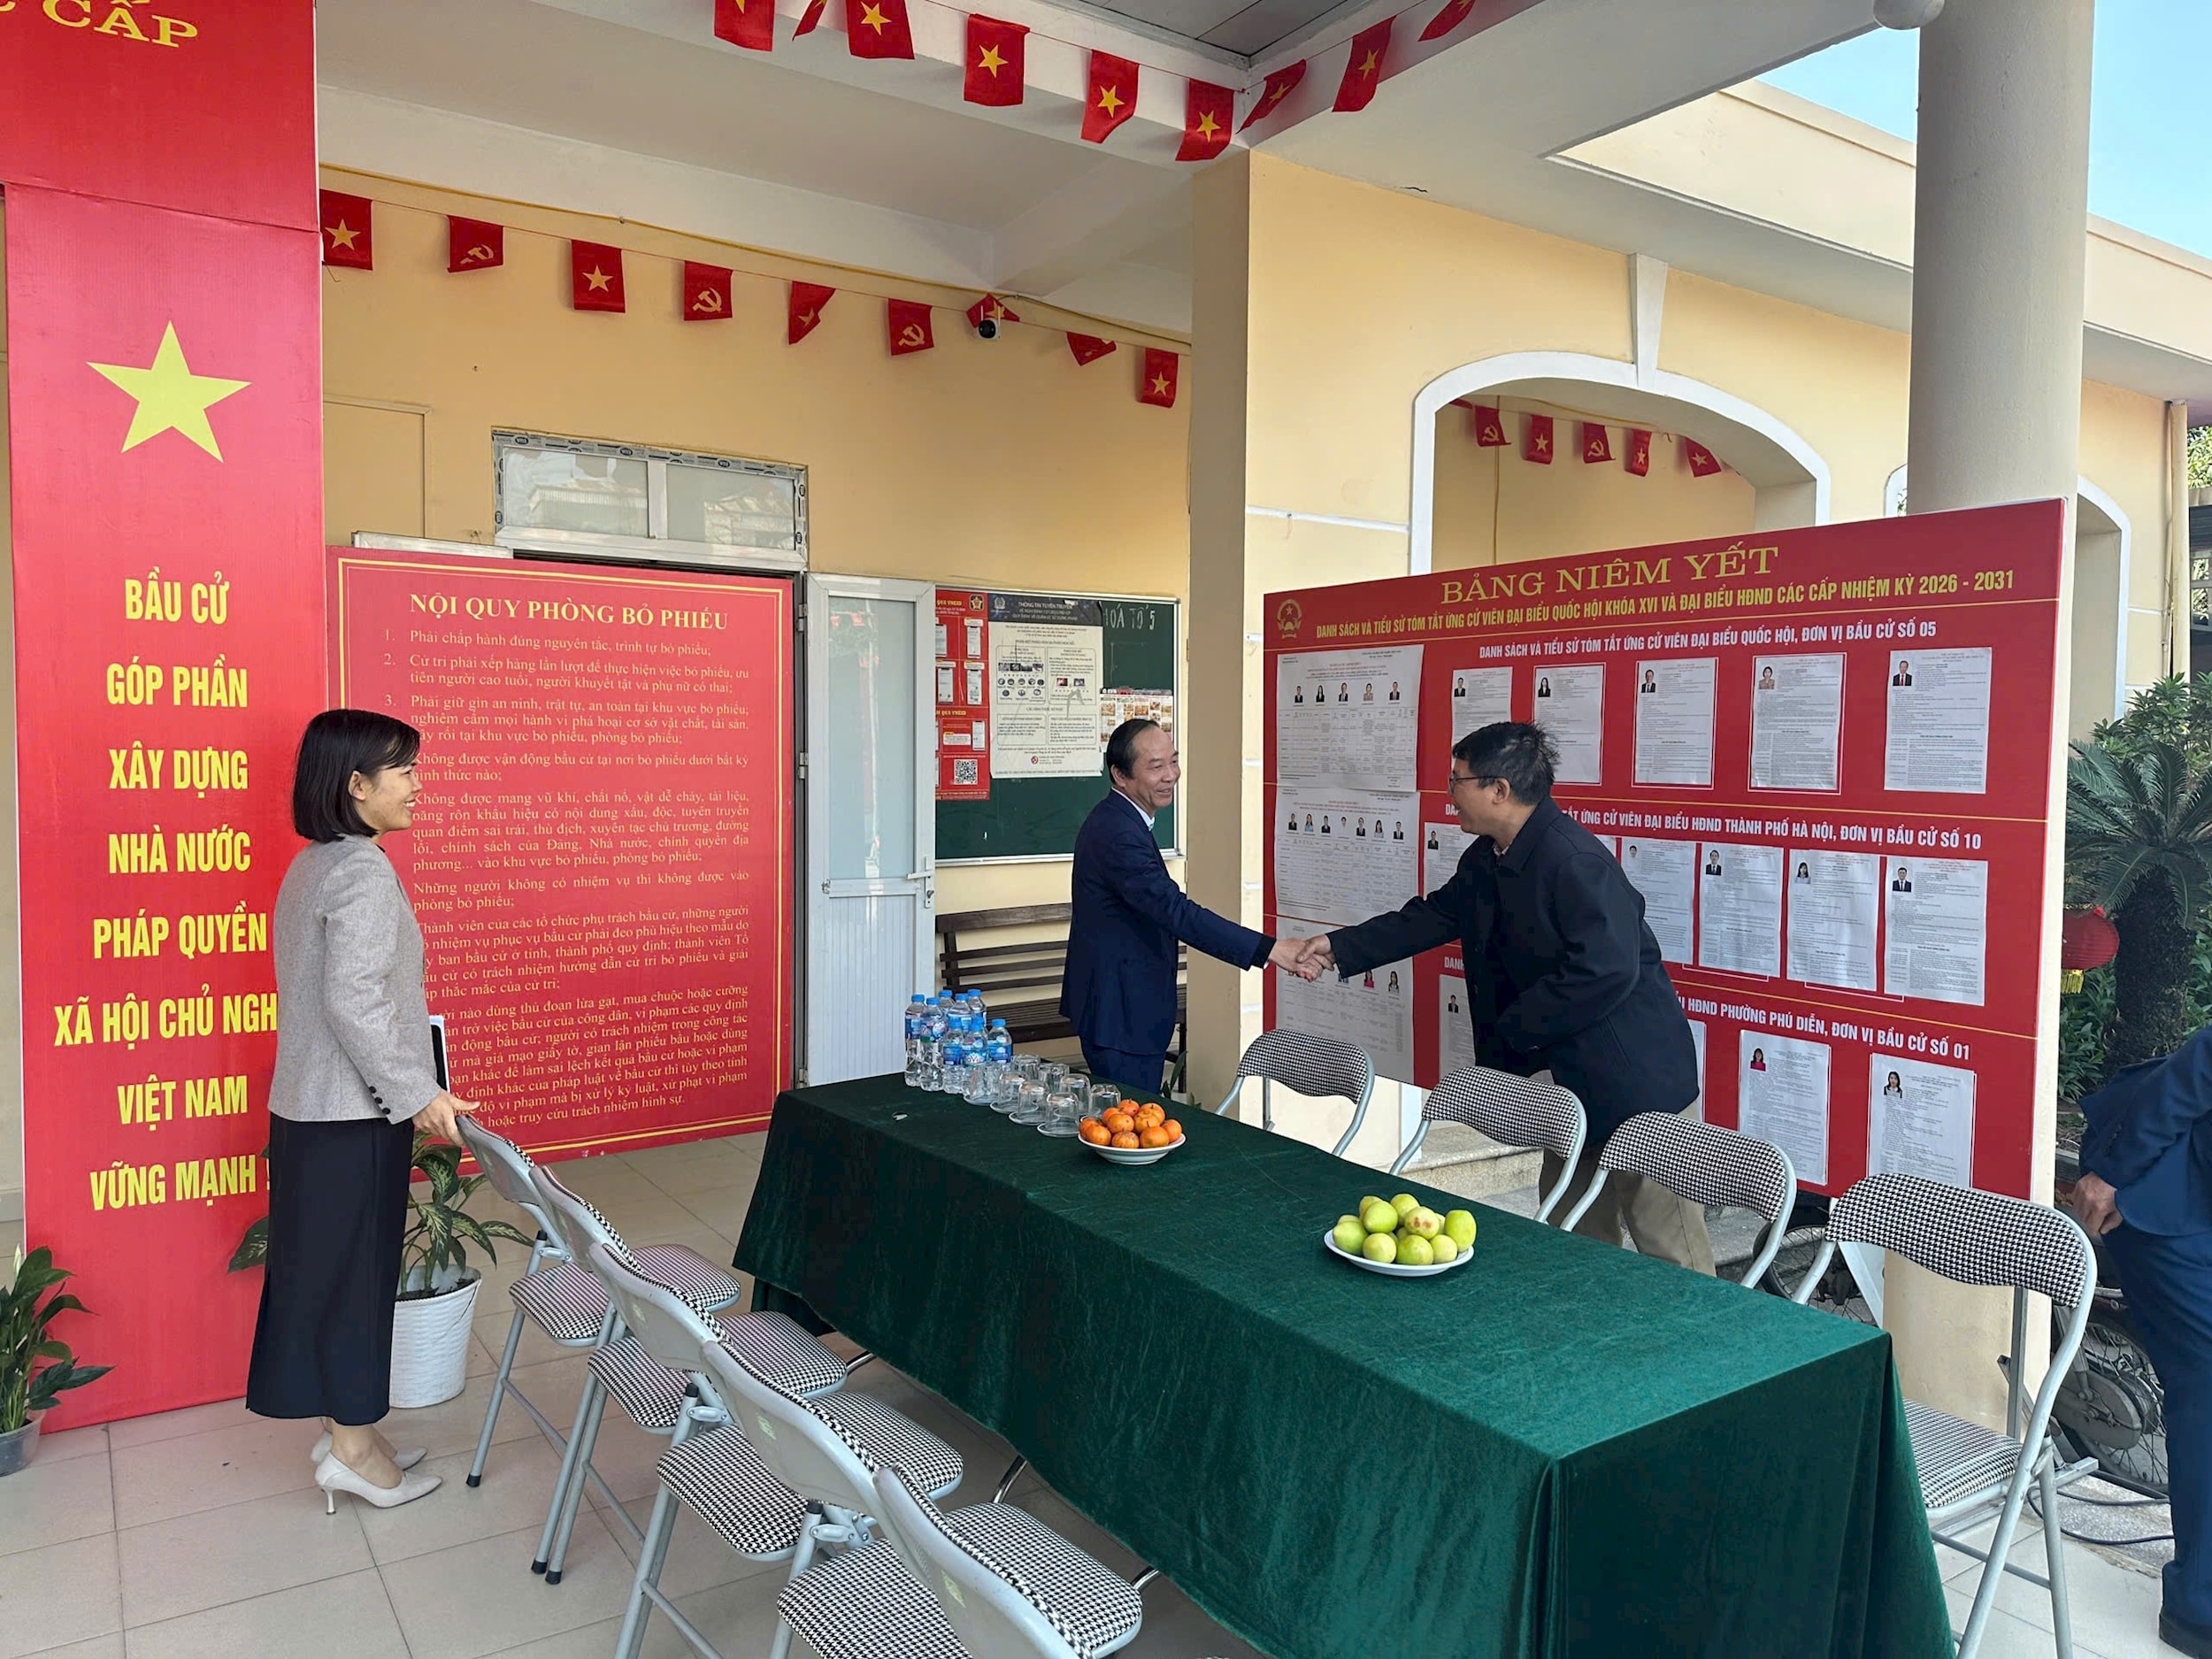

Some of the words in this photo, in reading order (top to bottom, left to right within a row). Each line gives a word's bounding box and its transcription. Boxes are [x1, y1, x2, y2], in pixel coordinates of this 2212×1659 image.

[125, 567, 181, 621] BẦU
[190, 572, 229, 623] CỬ
[1440, 572, 1545, 603] BẢNG
[1555, 557, 1671, 592] NIÊM
[1683, 541, 1778, 580] YẾT
[410, 592, 457, 618] NỘI
[465, 597, 521, 619] QUY
[527, 597, 614, 623] PHÒNG
[621, 603, 654, 625] BỎ
[660, 607, 727, 629] PHIẾU
[1149, 611, 1156, 630] 5
[1317, 624, 1337, 637] DANH
[1338, 622, 1360, 636] SÁCH
[1361, 621, 1371, 634] VÀ
[1373, 615, 1391, 634] TIỂU
[1393, 614, 1405, 632] SỬ
[1407, 615, 1425, 631] TÓM
[1427, 611, 1443, 629] TẮT
[1445, 612, 1464, 628] ỨNG
[1466, 608, 1479, 626] CỬ
[1482, 608, 1504, 625] VIÊN
[1506, 608, 1523, 626] ĐẠI
[1525, 601, 1549, 622] BIỂU
[1552, 598, 1580, 621] QUỐC
[1583, 598, 1601, 619] HỘI
[1604, 595, 1635, 615] KHÓA
[1639, 596, 1657, 613] XVI
[1661, 592, 1677, 611] VÀ
[1679, 593, 1701, 612] ĐẠI
[1703, 587, 1733, 608] BIỂU
[1736, 588, 1773, 605] HĐND
[1777, 582, 1804, 603] CÁC
[1809, 579, 1837, 601] CẤP
[1840, 576, 1890, 600] NHIỆM
[1894, 572, 1914, 595] KỲ
[1918, 573, 1957, 594] 2026
[1973, 570, 2013, 590] 2031
[386, 628, 395, 641] 1.
[410, 629, 437, 642] Phải
[442, 629, 472, 647] chấp
[476, 633, 506, 645] hành
[510, 634, 541, 649] đúng
[544, 638, 588, 650] nguyên
[591, 636, 611, 650] tắc,
[615, 641, 642, 651] trình
[645, 643, 657, 655] tự
[660, 642, 674, 653] bỏ
[677, 641, 710, 657] phiếu;
[1479, 645, 1502, 657] DANH
[1504, 642, 1527, 657] SÁCH
[1529, 641, 1541, 655] VÀ
[1543, 637, 1563, 654] TIỂU
[1565, 636, 1578, 653] SỬ
[1580, 637, 1601, 652] TÓM
[1603, 634, 1621, 651] TẮT
[1623, 634, 1644, 649] ỨNG
[1647, 631, 1662, 649] CỬ
[1663, 632, 1688, 648] VIÊN
[1690, 633, 1709, 649] ĐẠI
[1711, 626, 1738, 645] BIỂU
[1740, 625, 1771, 645] QUỐC
[1774, 625, 1798, 645] HỘI,
[1801, 625, 1827, 641] ĐƠN
[1831, 625, 1842, 642] VỊ
[1846, 619, 1872, 639] BẦU
[1875, 618, 1893, 638] CỬ
[1897, 617, 1916, 637] SỐ
[1919, 621, 1936, 636] 05
[106, 657, 163, 704] GÓP
[172, 655, 247, 706] PHẦN
[383, 652, 396, 664] 2.
[409, 654, 430, 666] Cử
[432, 655, 446, 666] tri
[449, 656, 477, 670] phải
[480, 655, 503, 672] xếp
[506, 657, 536, 673] hàng
[539, 657, 557, 671] lần
[560, 659, 584, 673] lượt
[586, 658, 601, 672] để
[603, 662, 628, 677] thực
[632, 663, 656, 676] hiện
[658, 664, 681, 677] việc
[684, 665, 698, 676] bỏ
[701, 664, 733, 679] phiếu,
[108, 741, 165, 788] XÂY
[173, 747, 248, 797] DỰNG
[1446, 803, 1459, 816] DA
[1580, 809, 1601, 824] ỨNG
[1602, 808, 1617, 825] CỬ
[1618, 810, 1641, 826] VIÊN
[1644, 814, 1662, 830] ĐẠI
[1664, 810, 1688, 829] BIỂU
[1691, 817, 1722, 832] HĐND
[1724, 817, 1762, 833] THÀNH
[1764, 818, 1788, 836] PHỐ
[1792, 819, 1808, 837] HÀ
[1811, 821, 1836, 841] NỘI,
[1839, 825, 1867, 841] ĐƠN
[1870, 826, 1883, 846] VỊ
[1886, 824, 1914, 844] BẦU
[1917, 826, 1938, 846] CỬ
[1939, 827, 1959, 848] SỐ
[1963, 833, 1981, 849] 10
[108, 825, 168, 872] NHÀ
[176, 825, 250, 872] NƯỚC
[93, 909, 169, 957] PHÁP
[178, 902, 266, 957] QUYỀN
[53, 996, 94, 1046] XÃ
[102, 993, 149, 1048] HỘI
[158, 984, 213, 1038] CHỦ
[222, 993, 277, 1033] NGH
[1687, 998, 1717, 1015] HĐND
[1720, 1003, 1766, 1024] PHƯỜNG
[1769, 1011, 1793, 1028] PHÚ
[1795, 1013, 1828, 1036] DIỄN,
[1831, 1022, 1857, 1040] ĐƠN
[1861, 1026, 1873, 1046] VỊ
[1877, 1026, 1904, 1048] BẦU
[1907, 1032, 1928, 1051] CỬ
[1929, 1035, 1948, 1056] SỐ
[1953, 1042, 1969, 1060] 01
[117, 1074, 176, 1130] VIỆT
[185, 1075, 248, 1118] NAM
[488, 1115, 517, 1127] hoặc
[518, 1113, 543, 1124] truy
[546, 1108, 568, 1119] cứu
[572, 1102, 600, 1117] trách
[603, 1099, 638, 1112] nhiệm
[641, 1094, 666, 1108] hình
[669, 1094, 685, 1105] sự.
[89, 1162, 165, 1210] VỮNG
[175, 1156, 256, 1205] MẠNH
